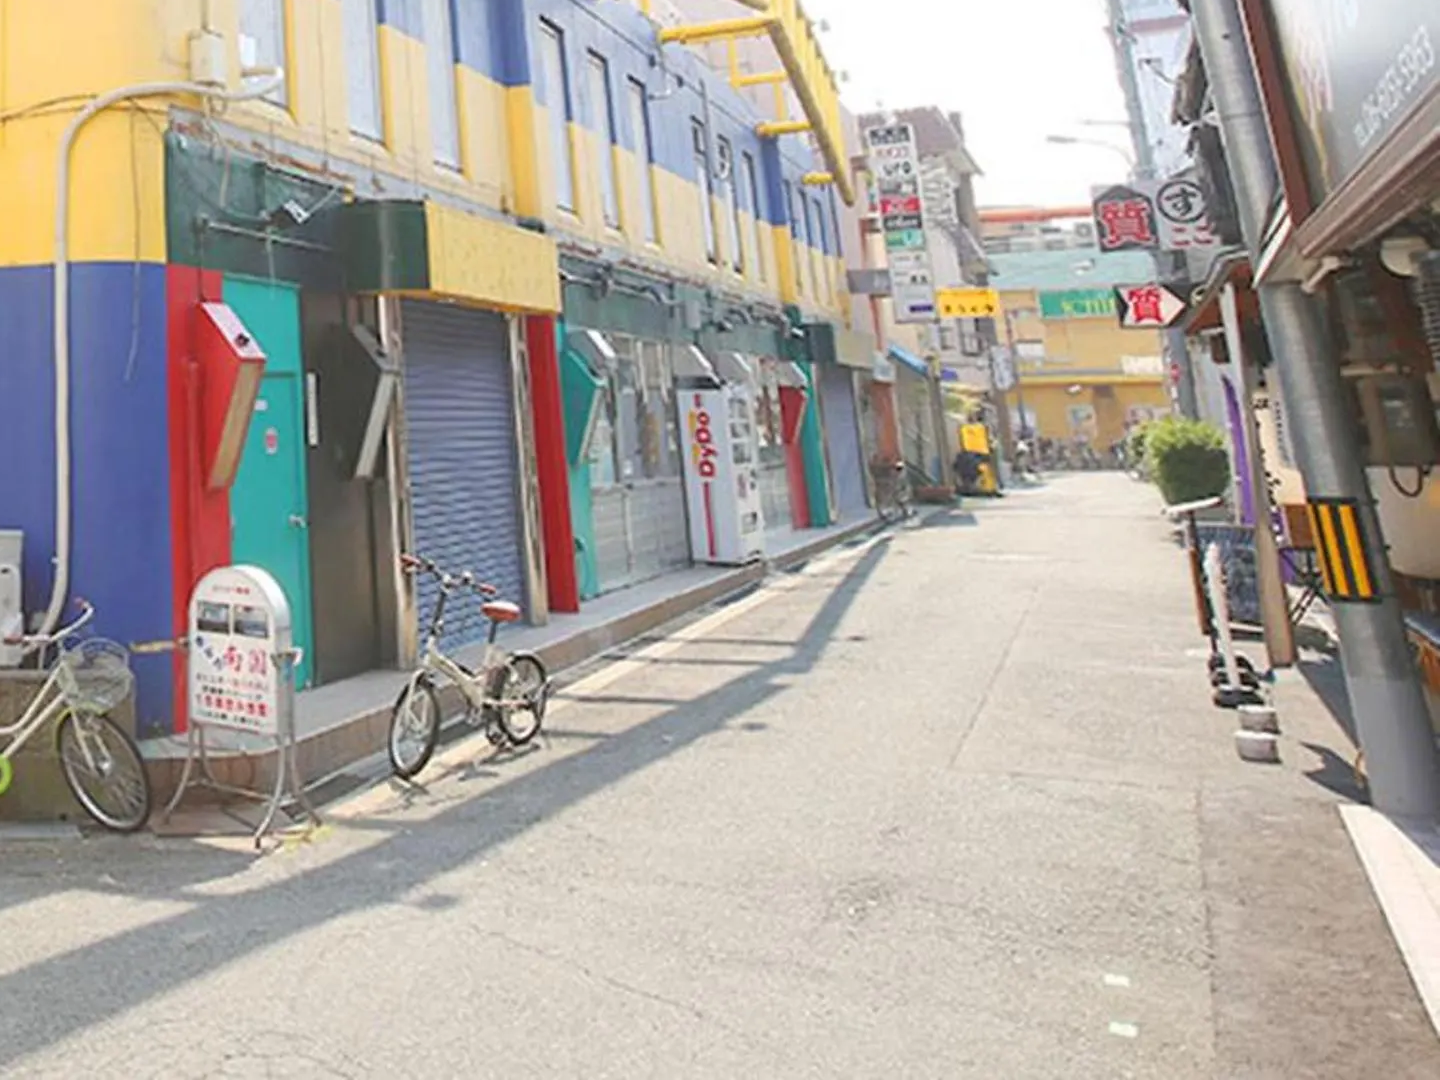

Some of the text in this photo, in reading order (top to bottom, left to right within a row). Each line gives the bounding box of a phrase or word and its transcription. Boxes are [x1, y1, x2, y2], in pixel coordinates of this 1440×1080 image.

[1101, 199, 1153, 245] 質
[1128, 281, 1164, 323] 質
[695, 411, 718, 478] DyDo
